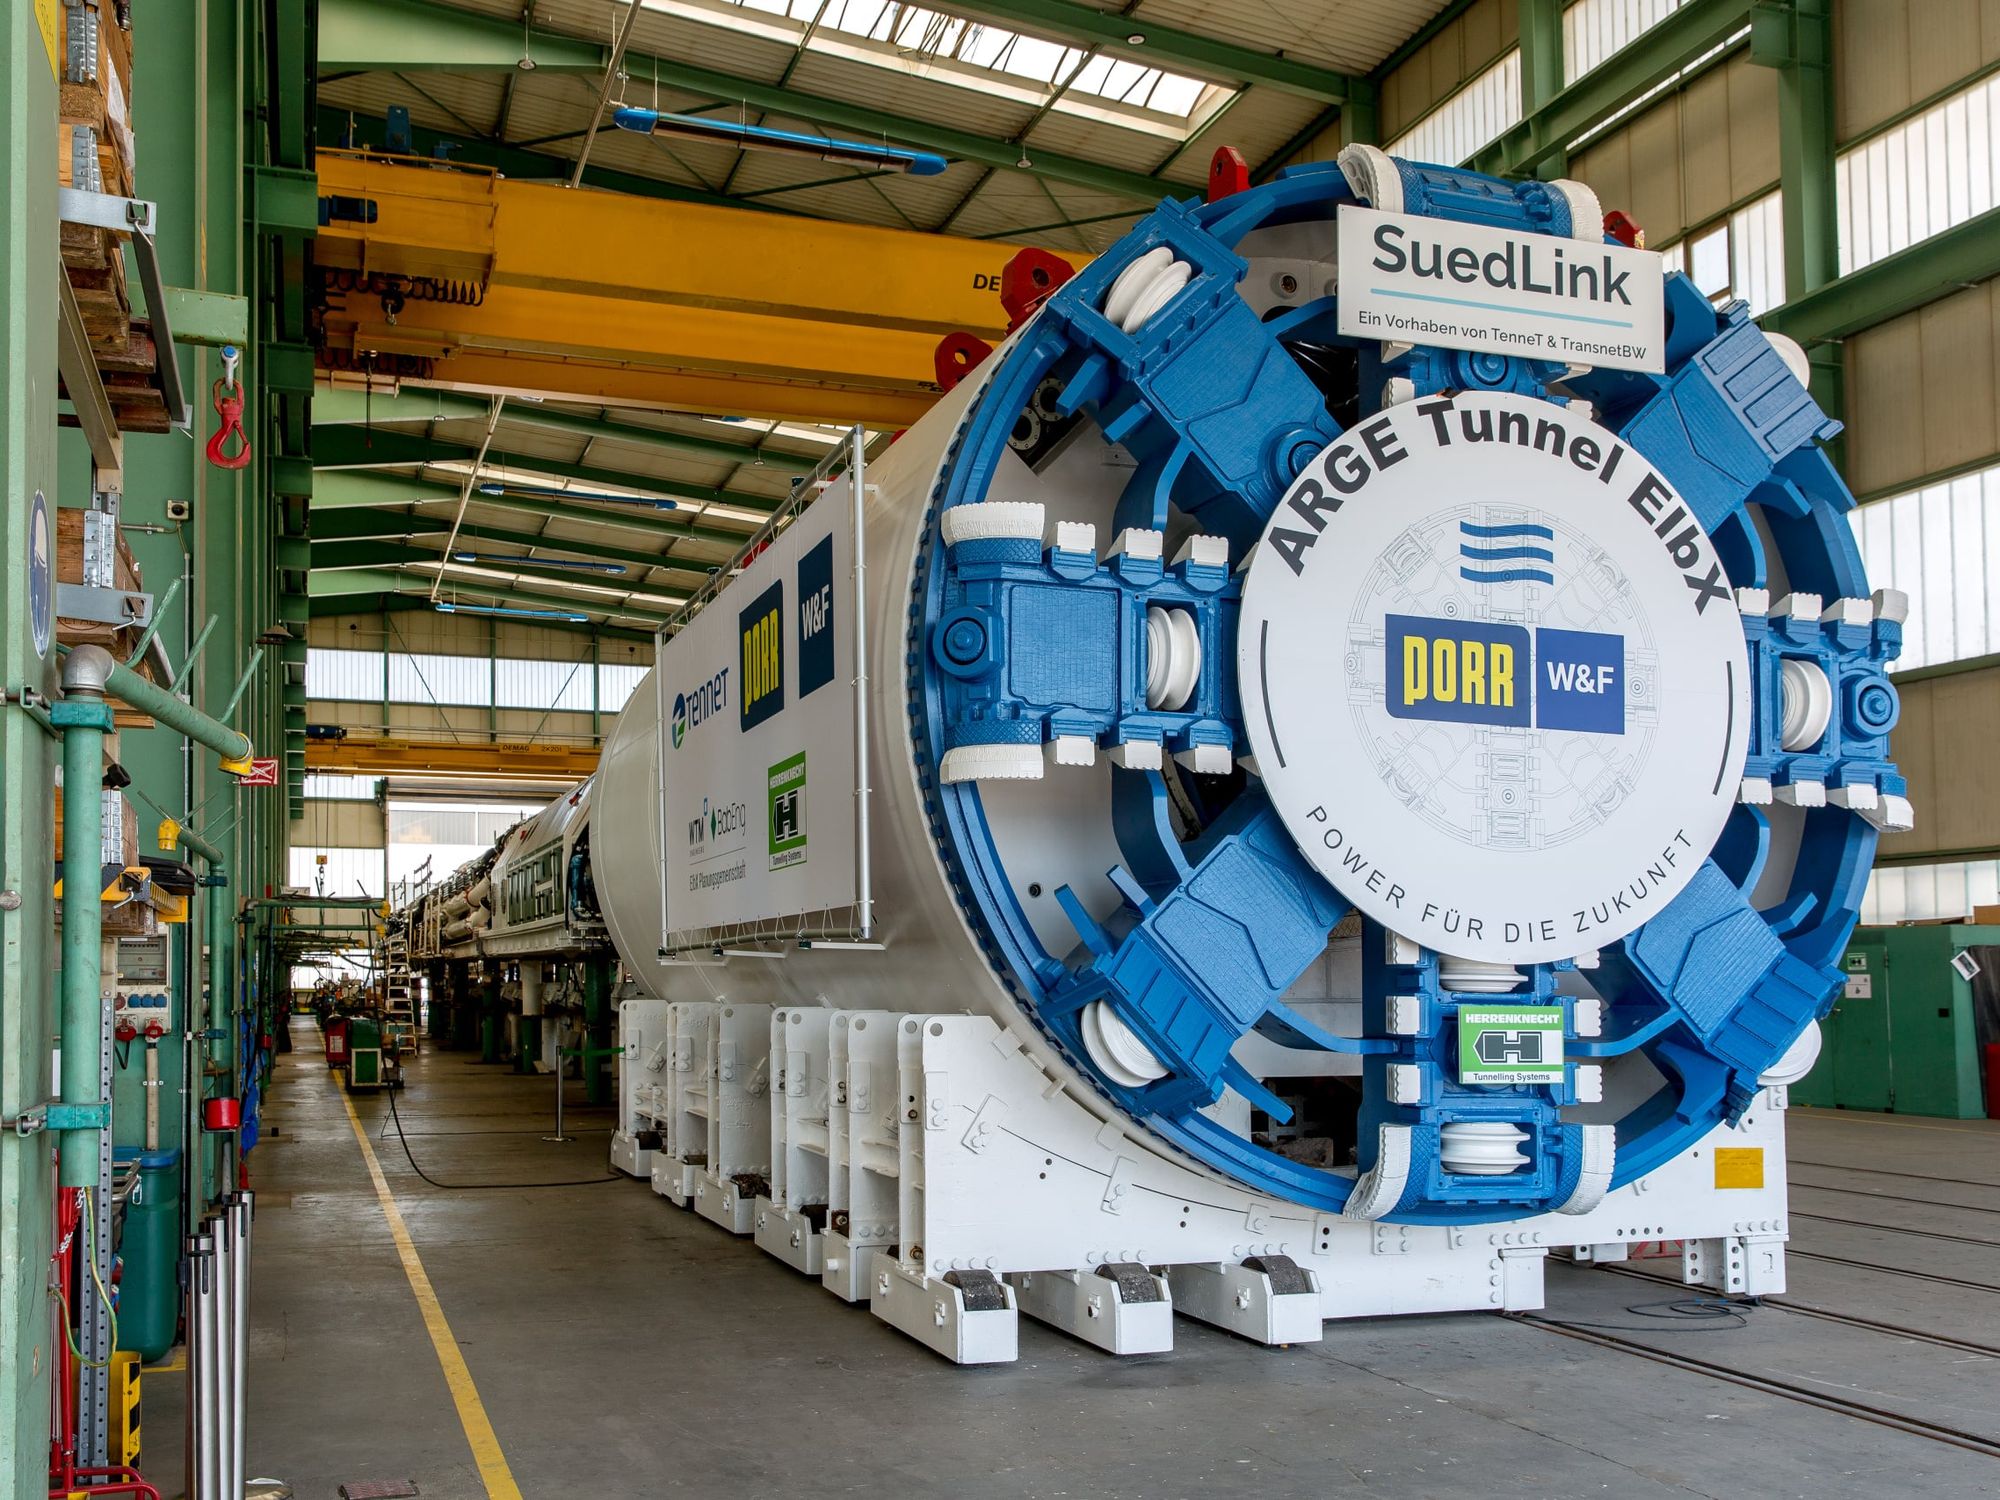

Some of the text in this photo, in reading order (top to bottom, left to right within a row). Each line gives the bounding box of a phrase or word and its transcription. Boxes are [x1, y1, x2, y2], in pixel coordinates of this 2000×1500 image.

[1372, 223, 1632, 306] SuedLink
[1358, 310, 1647, 360] Ein Vorhaben von TenneT & TransnetBW
[1267, 399, 1732, 616] ARGE Tunnel ElbX
[801, 584, 830, 641] W&F
[743, 607, 779, 715] PORR
[1403, 635, 1515, 708] PORR
[1547, 661, 1615, 695] W&F
[685, 666, 729, 730] TenneT
[688, 817, 705, 846] WTM
[717, 802, 746, 836] BabEng
[1306, 805, 1694, 943] POWER FÜR DIE ZUKUNFT
[1465, 1013, 1560, 1024] HERRENKNECHT
[1473, 1073, 1550, 1083] Tunnelling Systems
